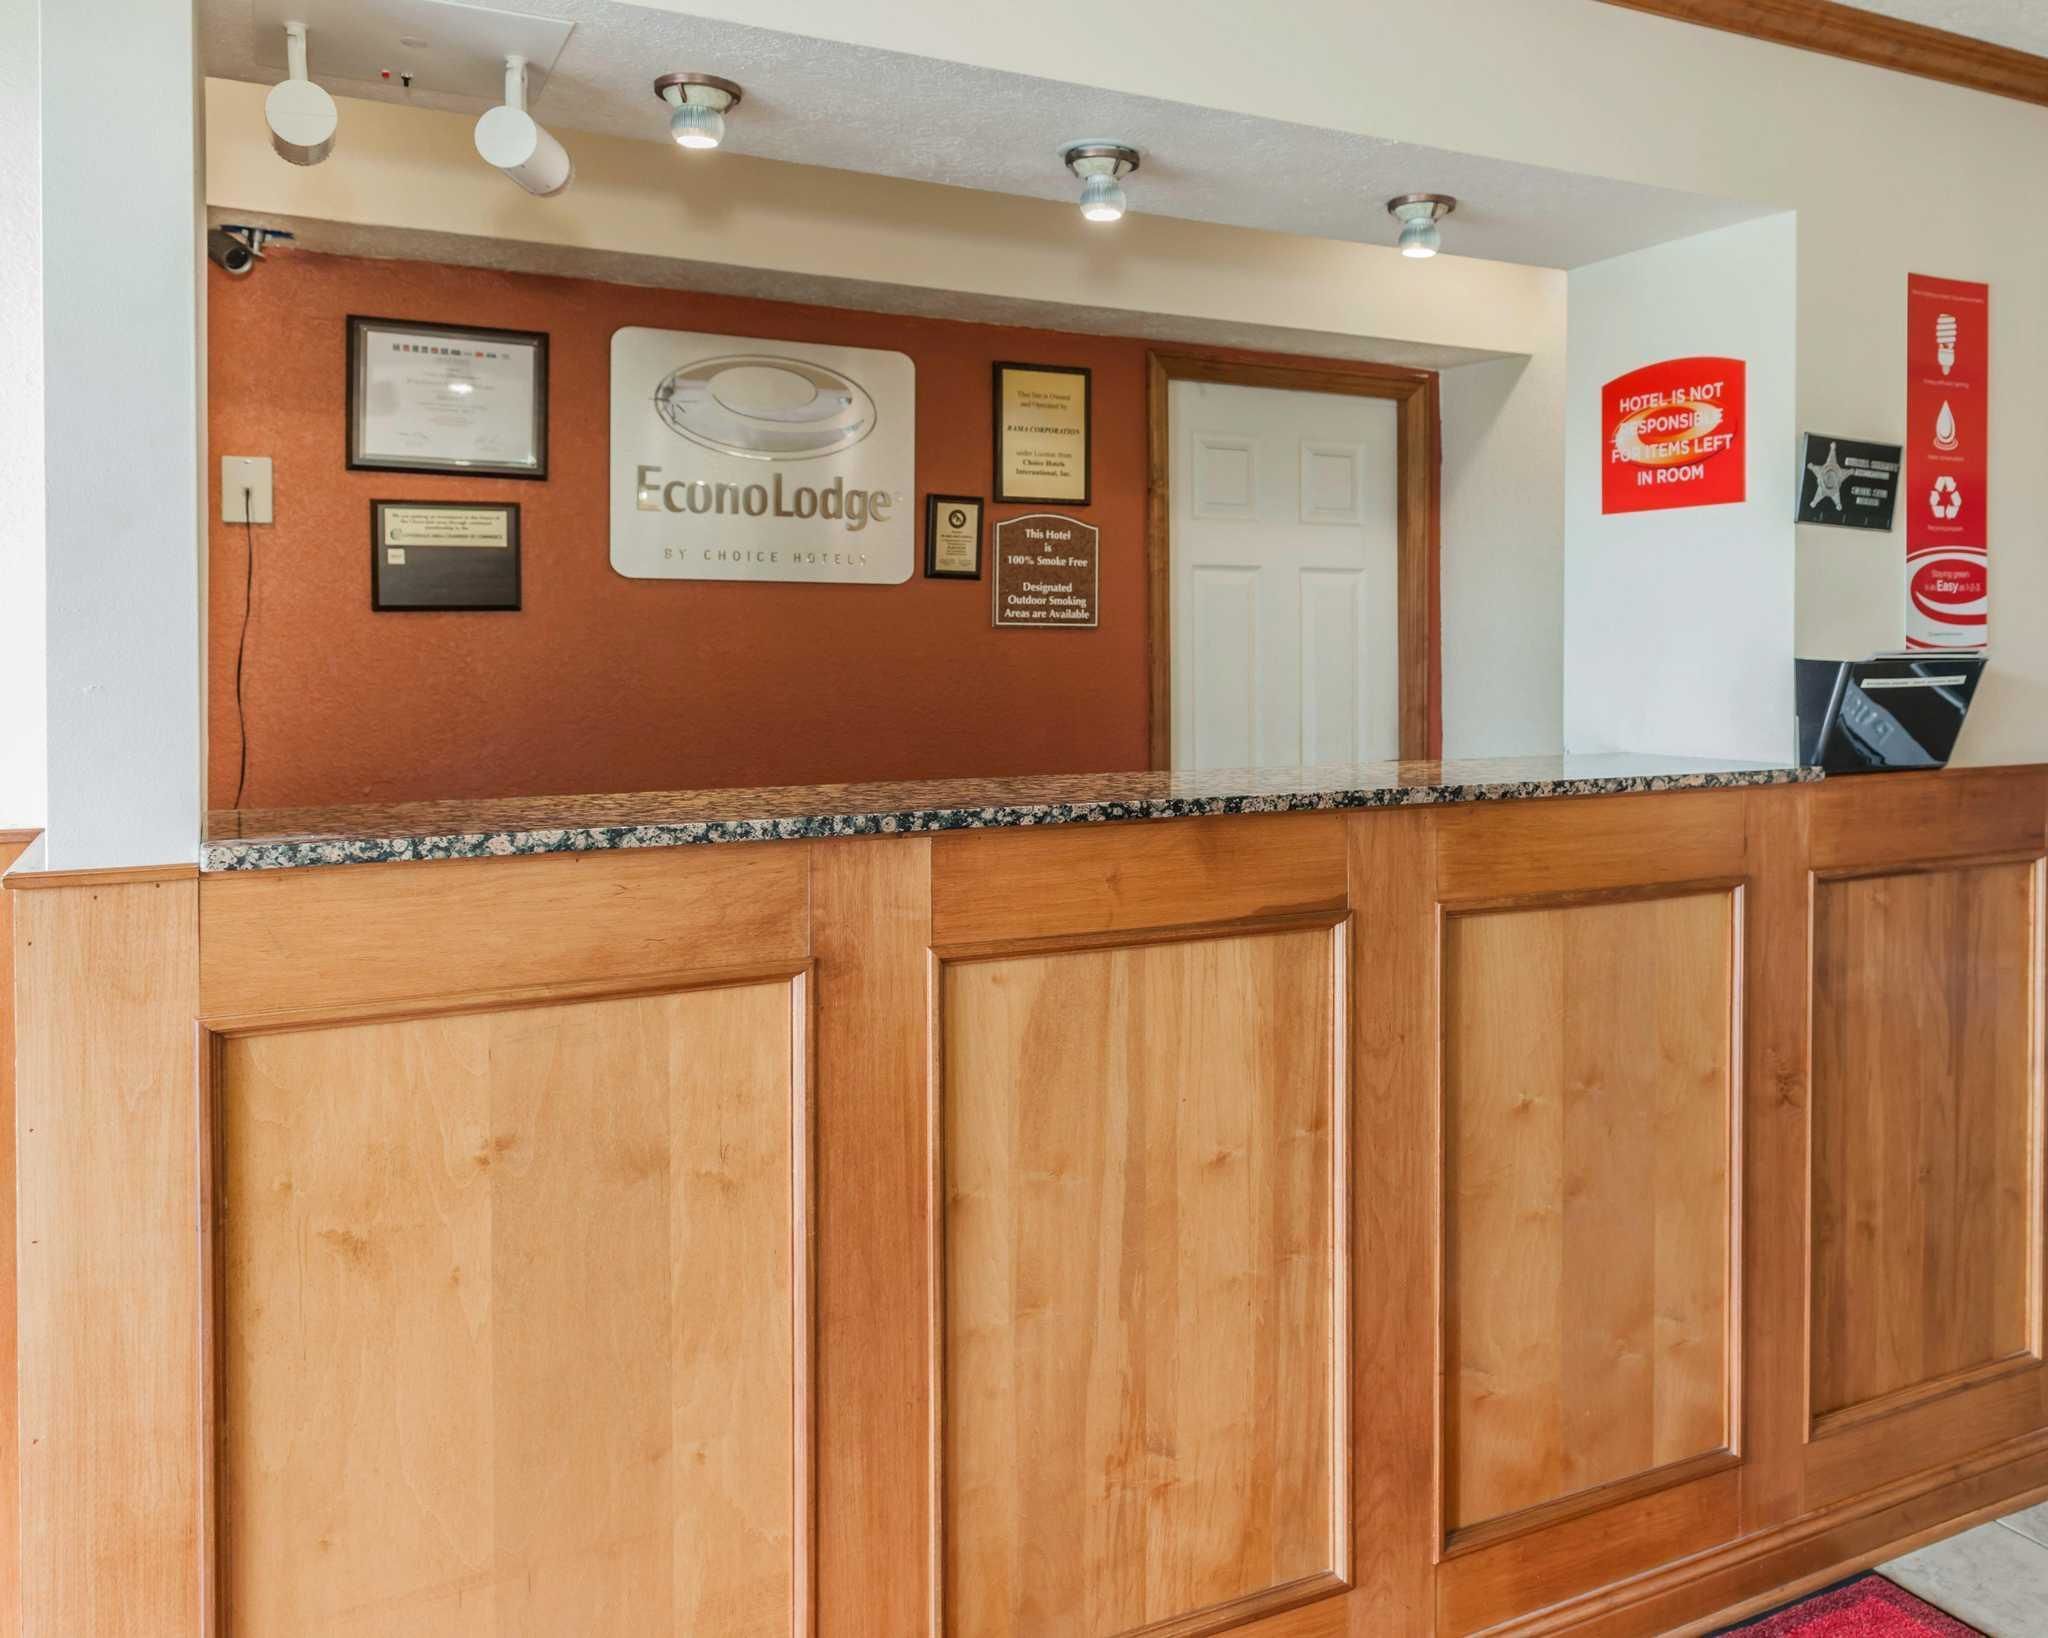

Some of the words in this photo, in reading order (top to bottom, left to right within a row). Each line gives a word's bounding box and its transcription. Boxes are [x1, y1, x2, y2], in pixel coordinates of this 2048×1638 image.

[1619, 392, 1668, 413] HOTEL
[1672, 388, 1686, 404] IS
[1689, 382, 1724, 401] NOT
[1620, 408, 1724, 437] SPONSIBE
[1030, 426, 1080, 436] CORPORATION
[1612, 446, 1640, 464] FO
[1694, 434, 1734, 454] LEFT
[1637, 472, 1652, 486] IN
[1656, 465, 1704, 484] ROOM
[1024, 529, 1044, 540] This
[1046, 530, 1072, 540] Hotel
[1044, 542, 1052, 552] is
[664, 548, 686, 559] BY
[704, 550, 778, 562] CHOICE
[793, 553, 867, 565] HOTELS
[1008, 556, 1034, 565] 100%
[1037, 556, 1067, 566] Smoke
[1069, 557, 1088, 568] Free
[1023, 582, 1072, 594] Designated
[1936, 580, 1959, 594] Easy
[1008, 594, 1046, 605] Outdoor
[1049, 596, 1086, 608] Smoking
[1004, 608, 1030, 618] Areas
[1032, 610, 1046, 618] are
[1049, 609, 1090, 620] Available
